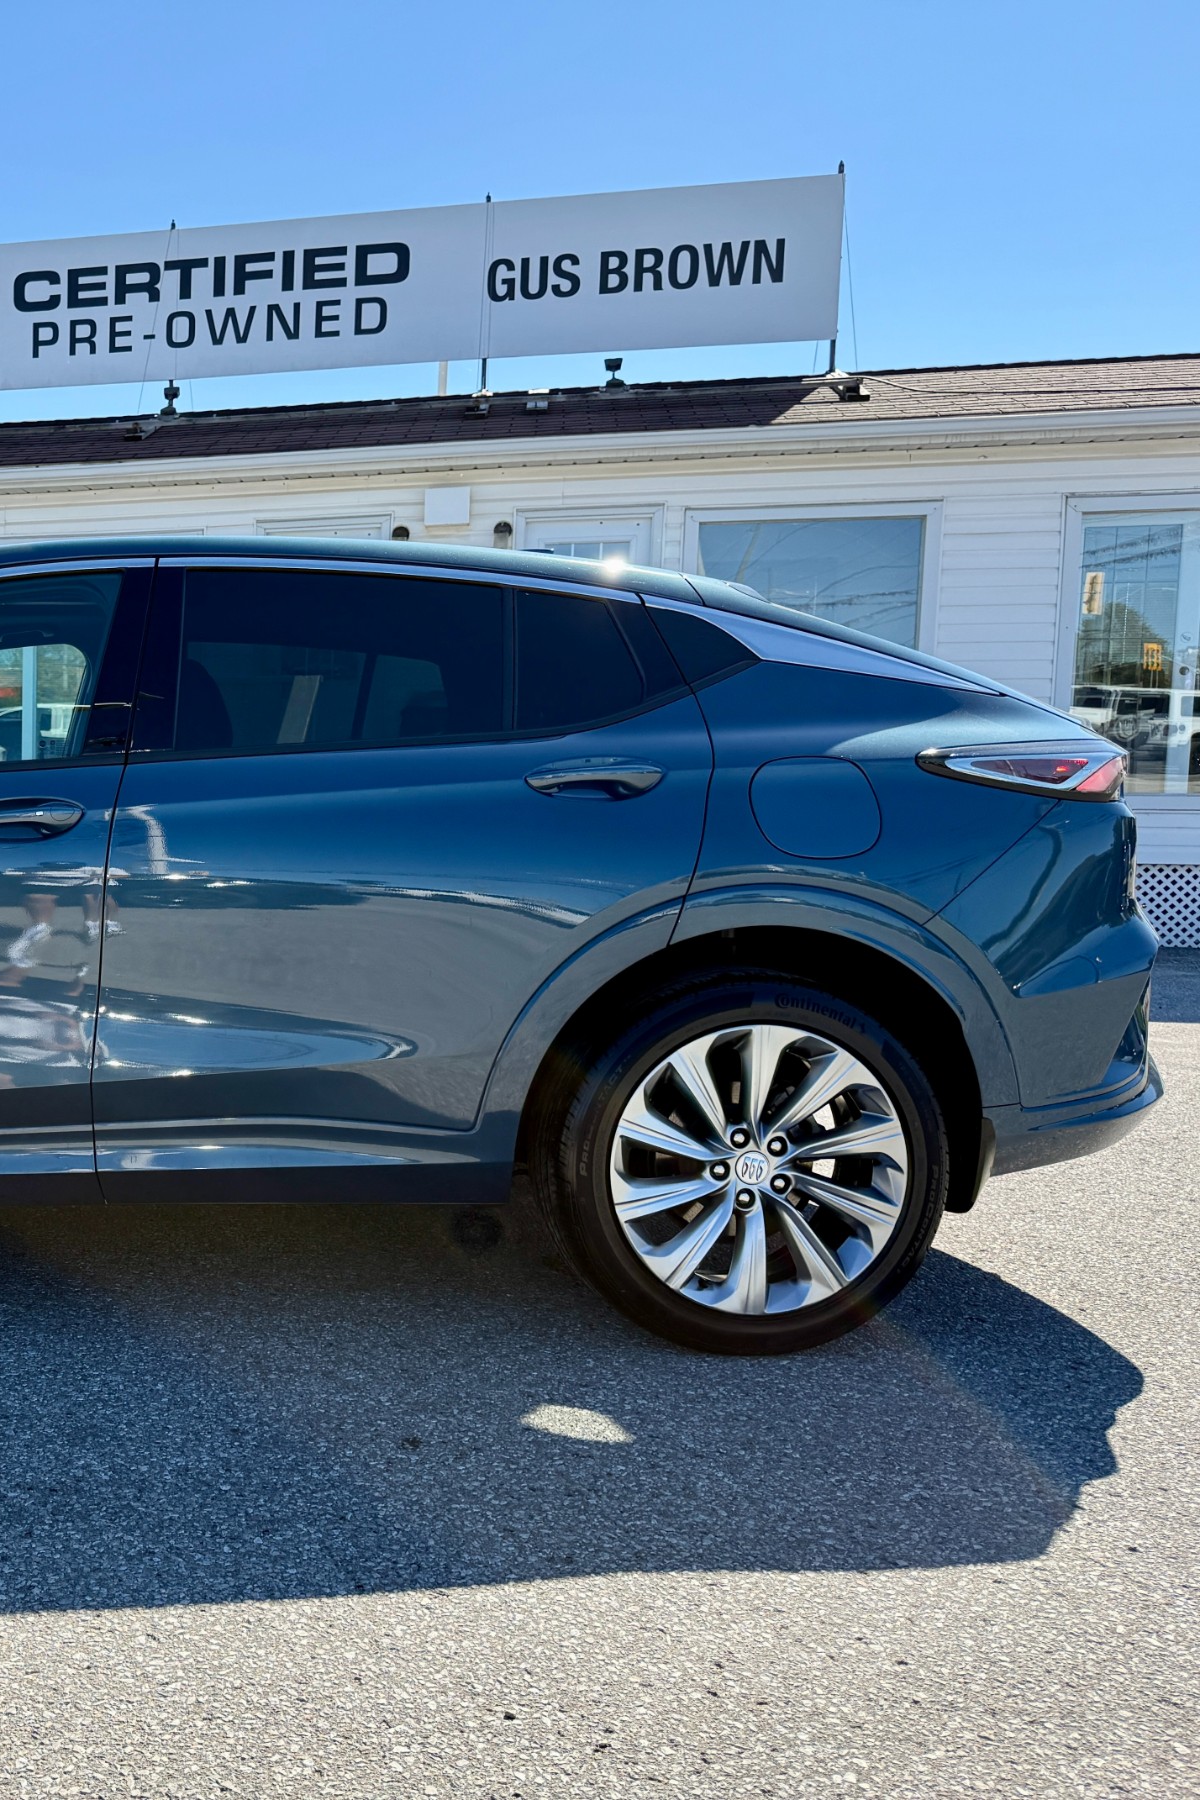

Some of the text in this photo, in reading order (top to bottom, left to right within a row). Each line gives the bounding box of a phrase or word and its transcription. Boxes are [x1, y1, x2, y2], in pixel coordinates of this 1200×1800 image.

[13, 242, 410, 312] CERTIFIED
[487, 238, 786, 302] GUS BROWN
[32, 296, 388, 359] PRE-OWNED
[775, 993, 857, 1029] Continental
